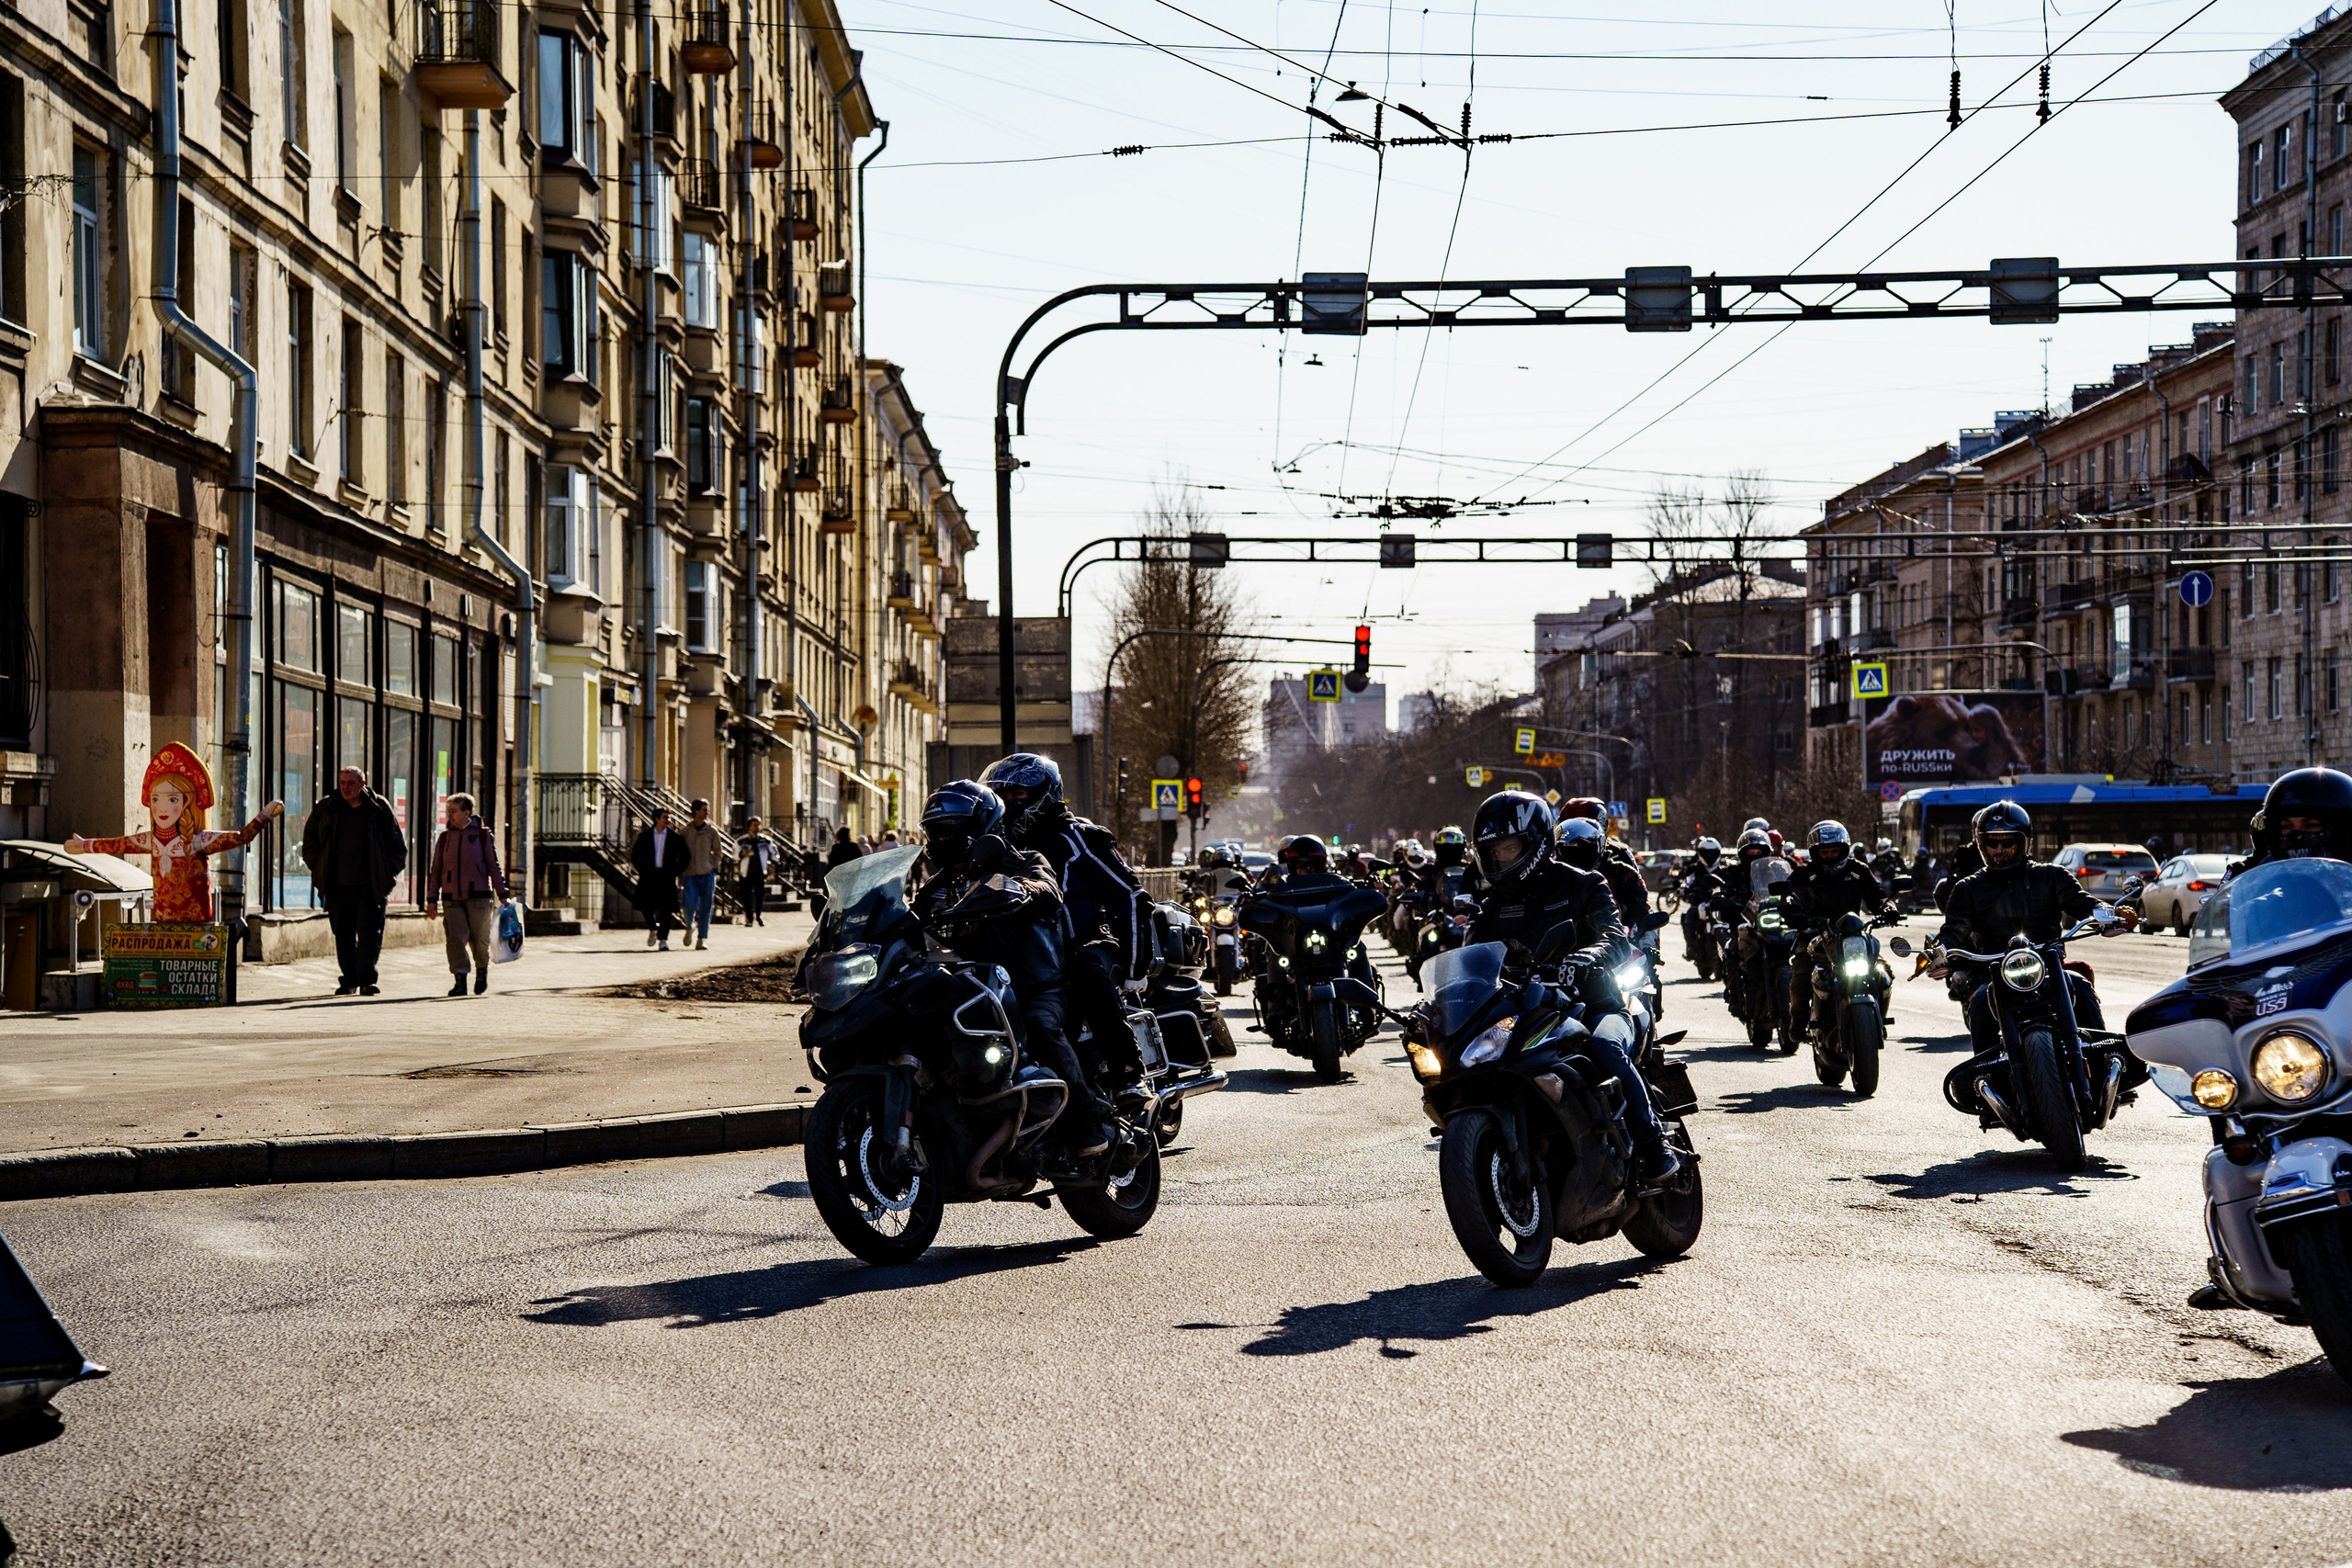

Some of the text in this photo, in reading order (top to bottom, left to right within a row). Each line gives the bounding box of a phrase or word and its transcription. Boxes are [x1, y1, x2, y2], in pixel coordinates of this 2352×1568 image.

[1881, 749, 1956, 762] ДРУЖИТЬ
[1881, 761, 1952, 773] по-RUSSки
[1477, 832, 1497, 842] SHARK
[1519, 840, 1546, 880] SHARK
[111, 938, 191, 950] РАСПРОДАЖА
[160, 960, 218, 972] ТОВАРНЫЕ
[168, 972, 217, 984] ОСТАТКИ
[116, 980, 135, 989] ВХОД
[171, 983, 217, 996] СКЛАДА
